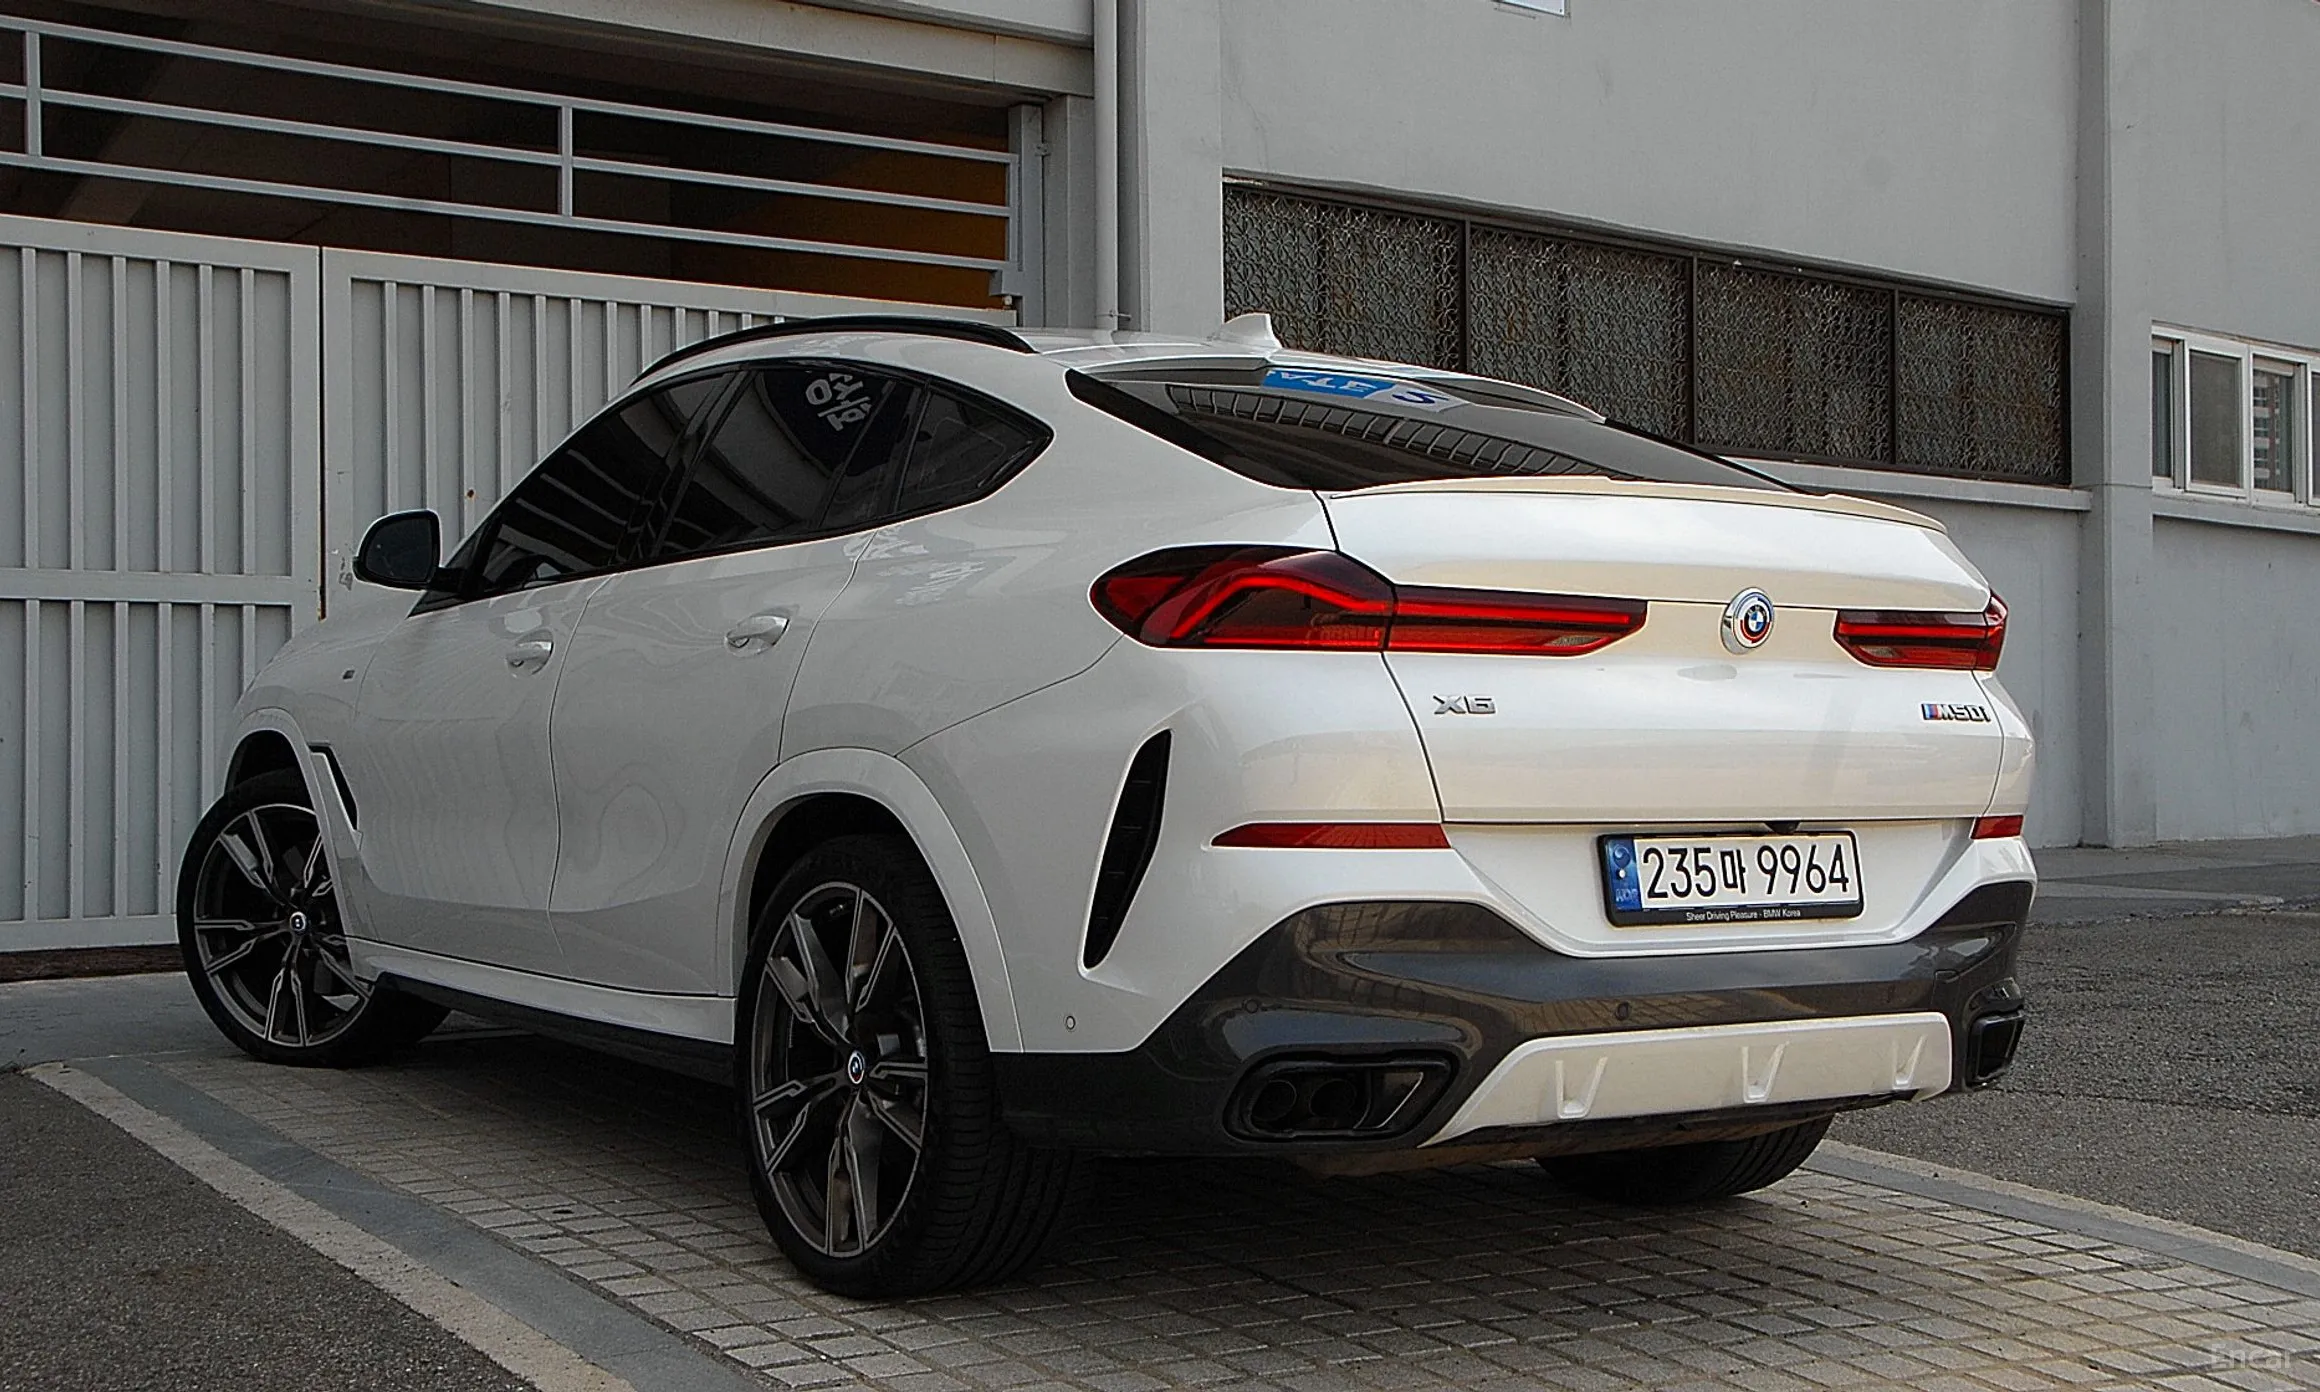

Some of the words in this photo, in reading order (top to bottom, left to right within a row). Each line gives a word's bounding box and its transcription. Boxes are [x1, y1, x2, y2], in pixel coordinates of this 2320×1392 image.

[1432, 695, 1497, 715] X6
[1642, 845, 1747, 900] 235마
[1756, 843, 1850, 896] 9964
[1685, 911, 1706, 921] Sheer
[1706, 911, 1730, 922] Driving
[1730, 909, 1758, 920] Pleasure
[1763, 908, 1781, 919] BMW
[1782, 908, 1801, 918] Korea
